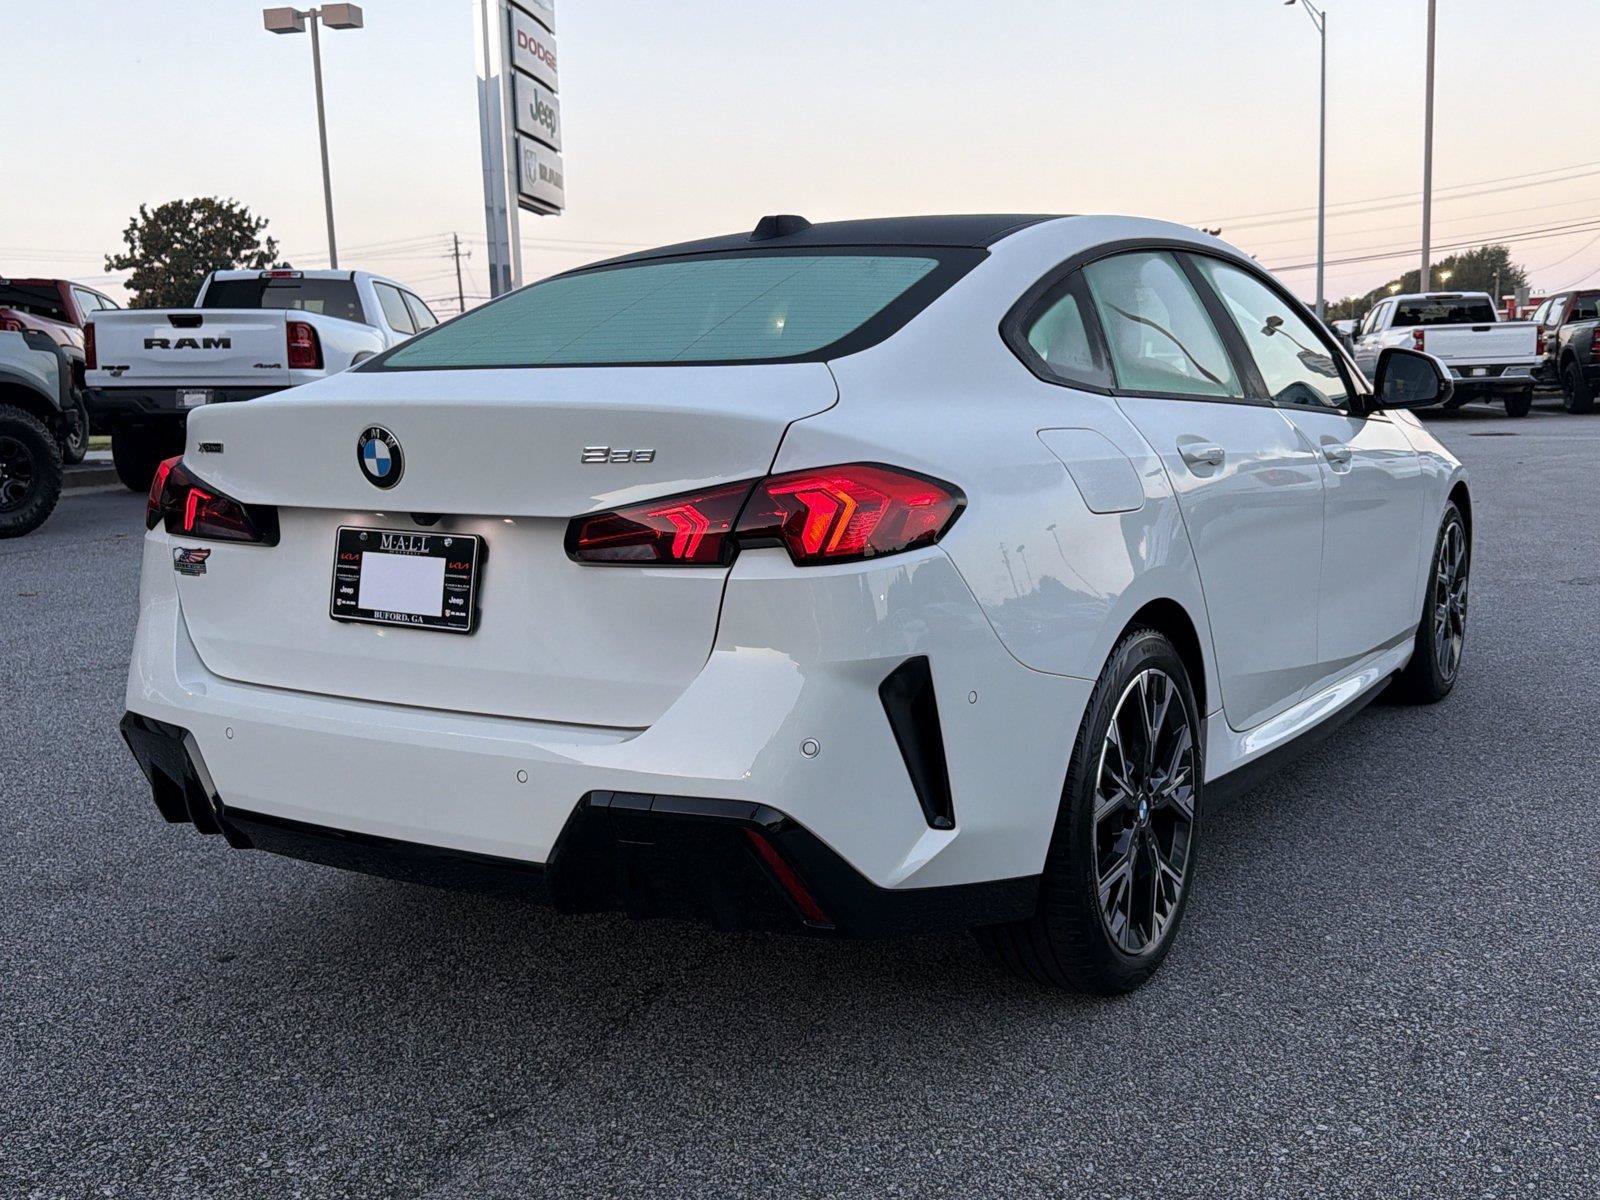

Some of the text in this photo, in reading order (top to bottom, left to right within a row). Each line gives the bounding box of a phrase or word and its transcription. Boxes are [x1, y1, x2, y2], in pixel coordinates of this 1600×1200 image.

[517, 29, 557, 71] DODGE
[530, 88, 556, 138] Jeep
[144, 338, 232, 350] RAM
[359, 428, 397, 449] BMW
[339, 586, 354, 595] Jeep
[448, 596, 465, 606] Jeep
[411, 615, 424, 624] GA
